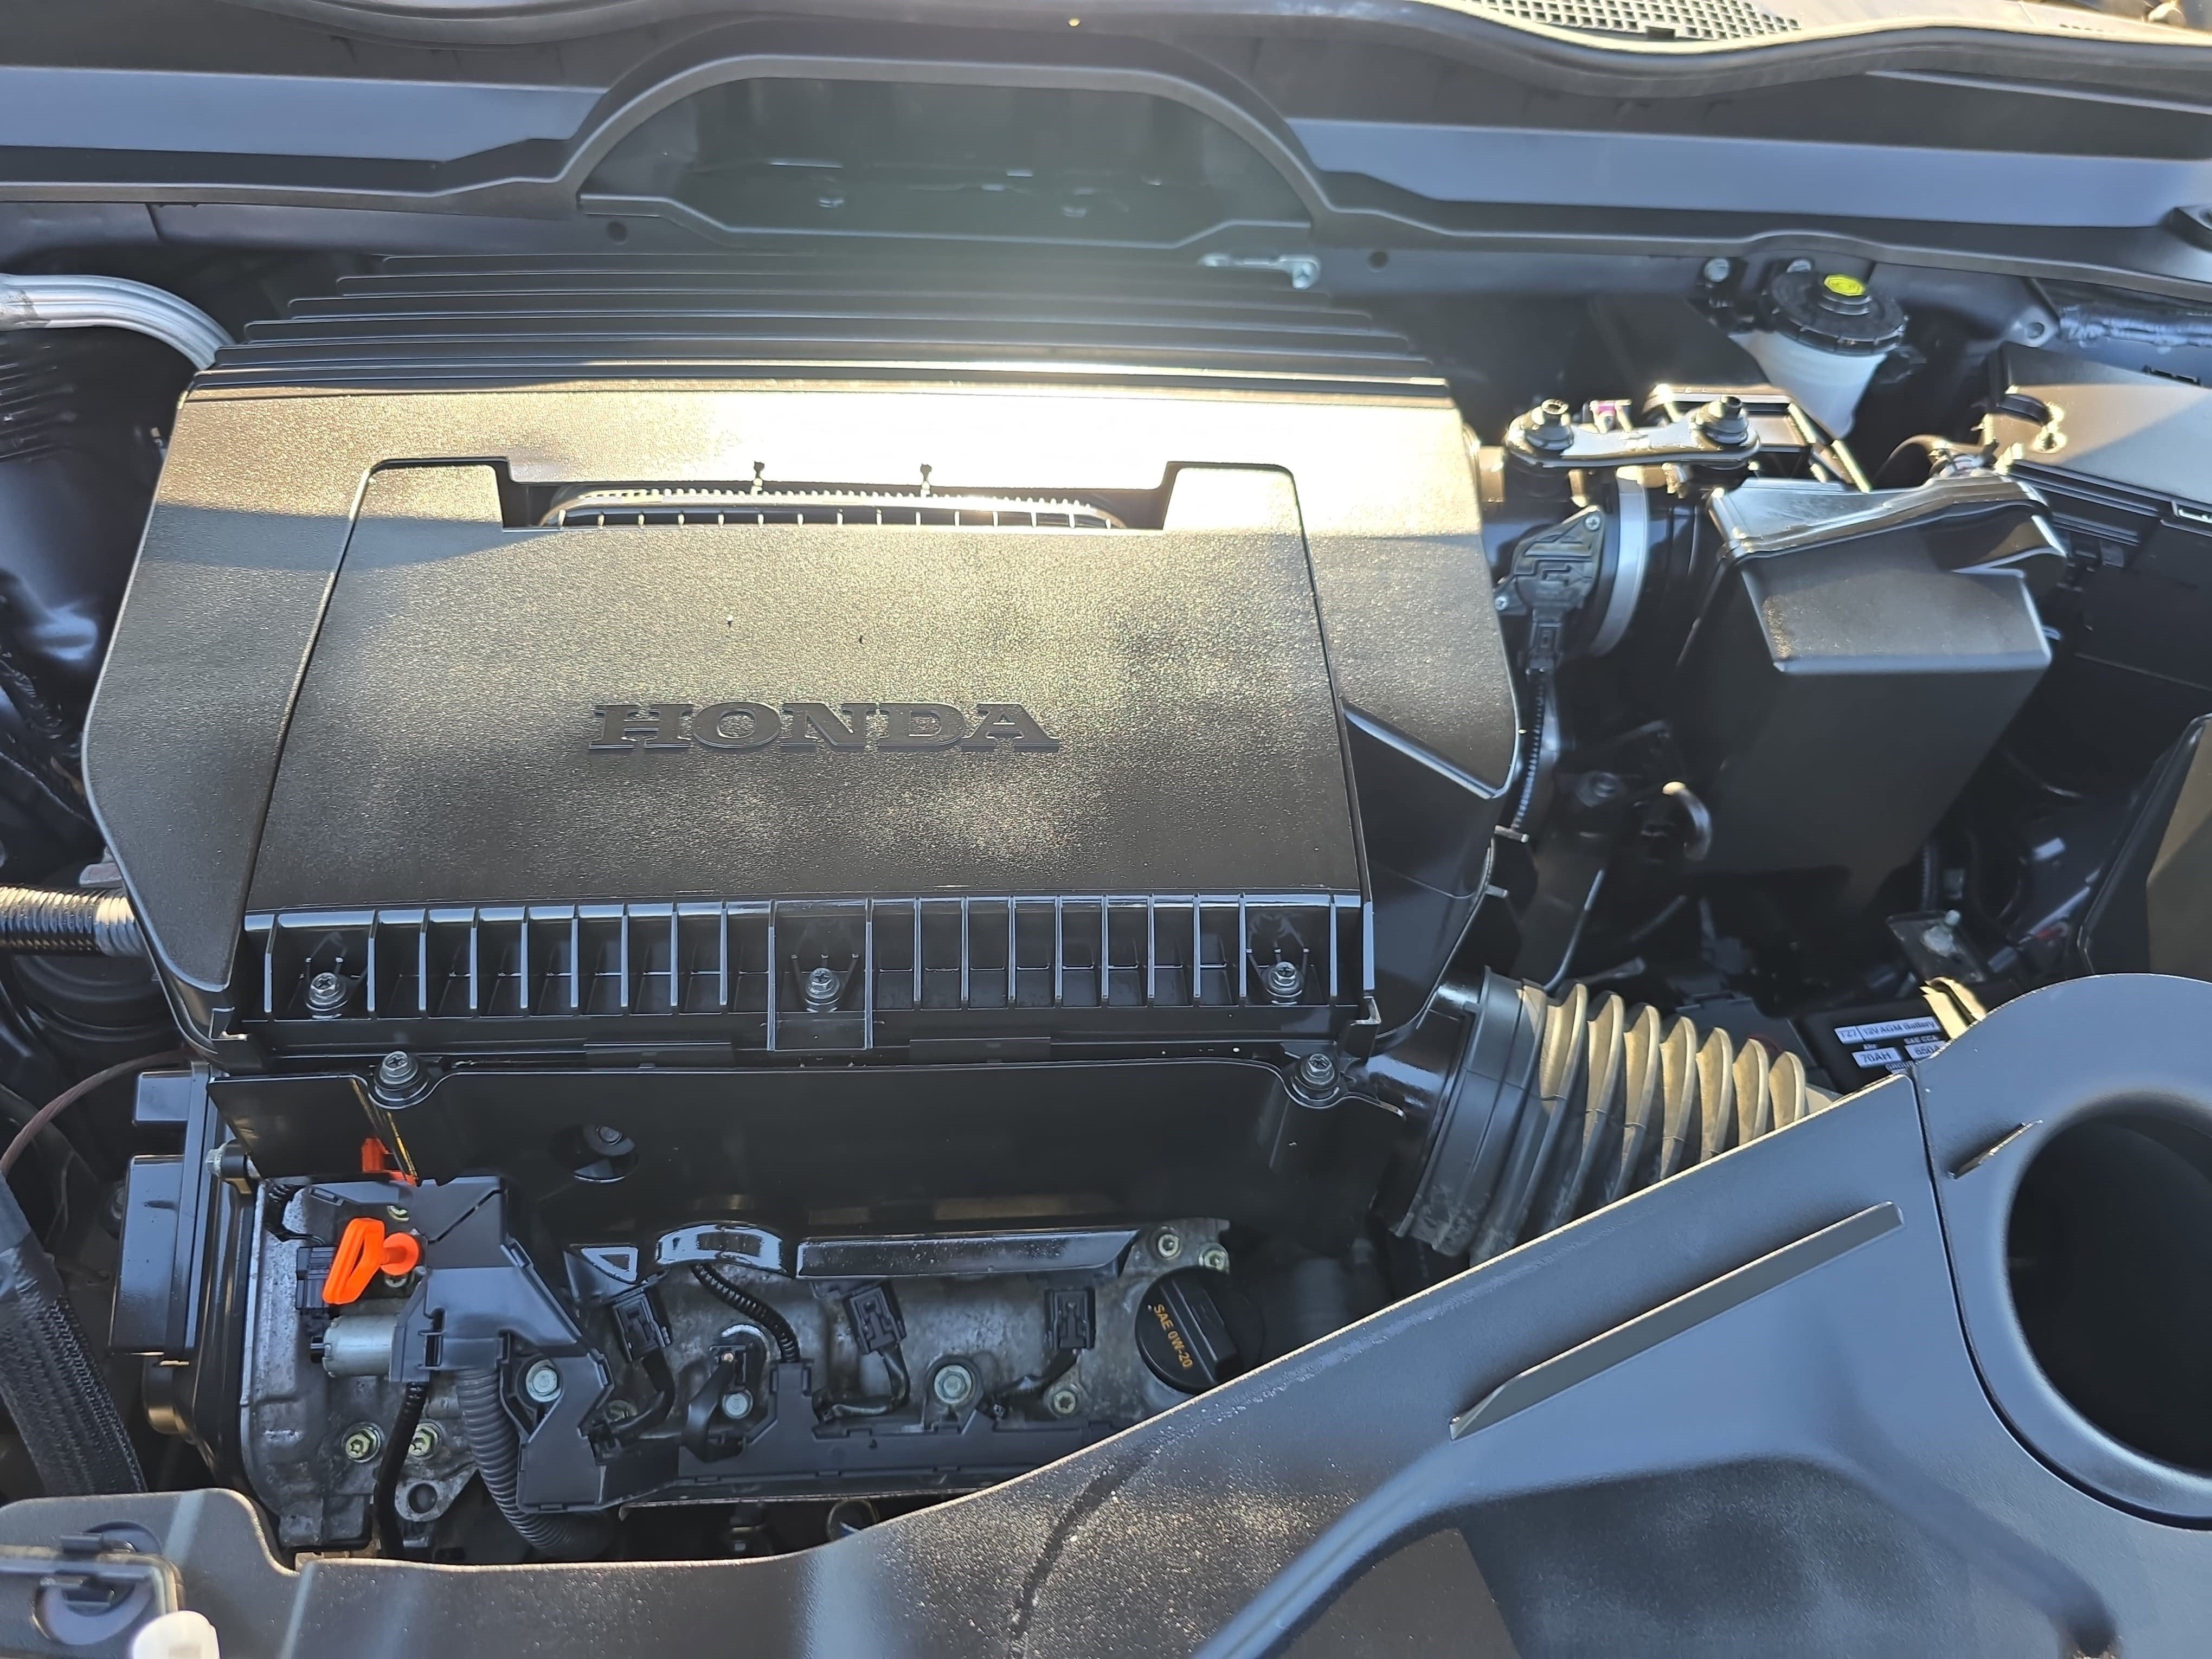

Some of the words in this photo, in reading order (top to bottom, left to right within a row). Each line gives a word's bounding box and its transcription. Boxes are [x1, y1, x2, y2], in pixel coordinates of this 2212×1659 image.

[589, 701, 1060, 750] HONDA
[1881, 1024, 1902, 1033] AGM
[1904, 1020, 1935, 1030] Battery
[1860, 1051, 1892, 1063] 70AH
[1154, 1304, 1174, 1332] SAE
[1167, 1330, 1193, 1367] 0W-20
